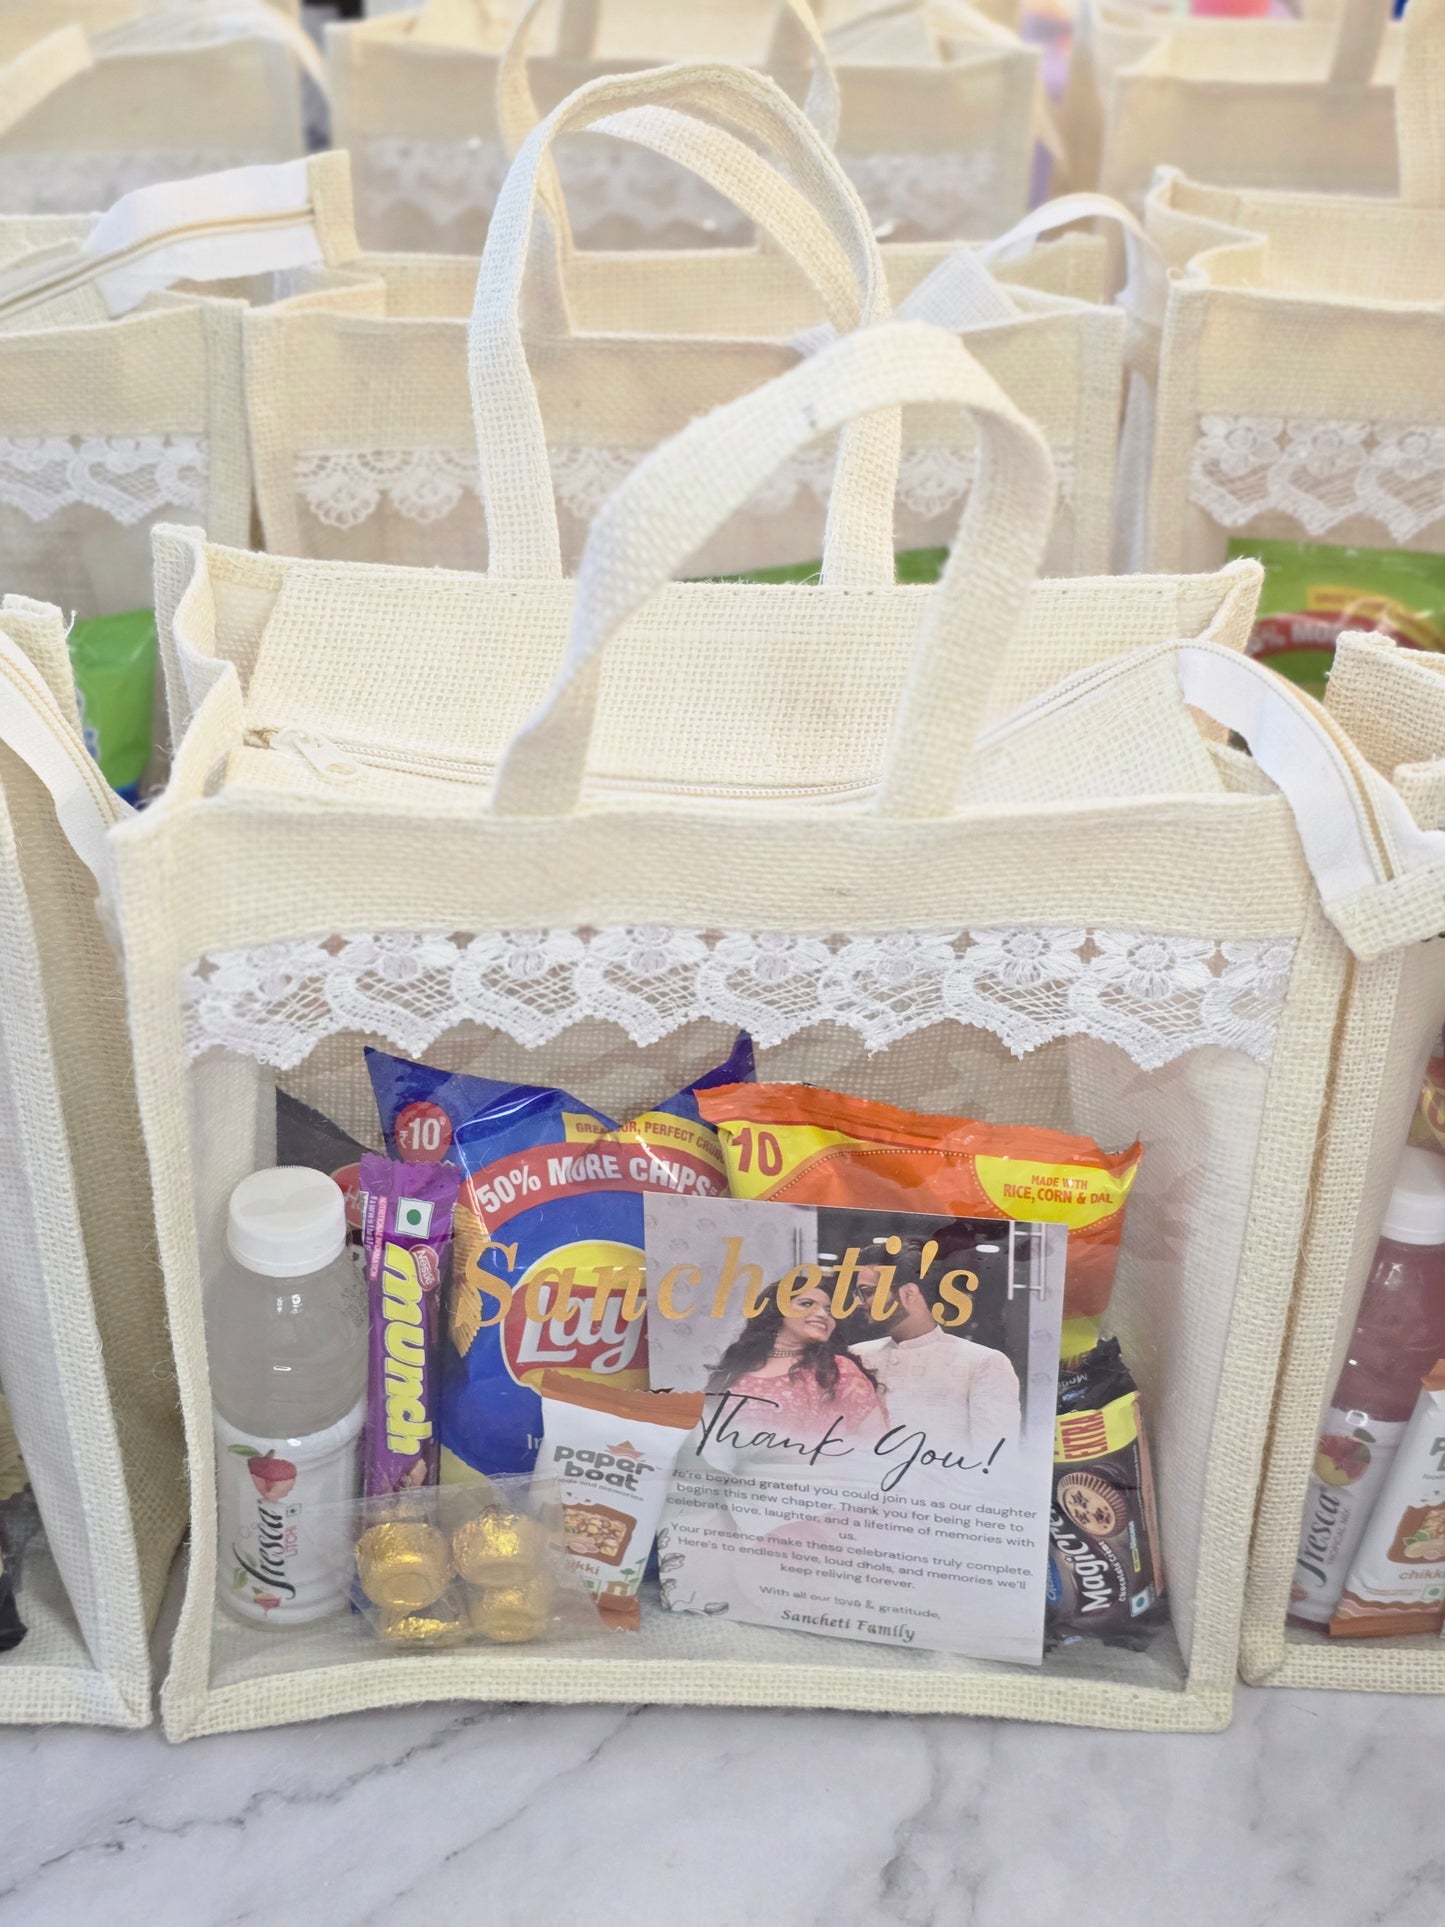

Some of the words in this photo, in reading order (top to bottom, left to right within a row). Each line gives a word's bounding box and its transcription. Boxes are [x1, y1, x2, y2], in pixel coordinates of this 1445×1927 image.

[645, 1122, 695, 1143] PERFECT
[731, 1127, 784, 1177] 10
[476, 1165, 542, 1213] 50%
[547, 1153, 623, 1187] MORE
[1003, 1184, 1036, 1204] RICE,
[1037, 1188, 1073, 1204] CORN
[1076, 1192, 1087, 1205] &
[1090, 1193, 1113, 1204] DAL
[1031, 1175, 1060, 1188] MADE
[1062, 1178, 1088, 1190] WITH
[455, 1235, 980, 1328] Sancheti's
[696, 1390, 855, 1466] Thank
[874, 1424, 1006, 1493] You!
[1060, 1409, 1109, 1460] EXTRA
[553, 1445, 655, 1476] paper
[564, 1461, 639, 1492] boat
[676, 1482, 720, 1496] begins
[724, 1488, 748, 1500] this
[751, 1493, 777, 1503] new
[781, 1496, 836, 1511] chapter.
[839, 1501, 880, 1515] Thank
[882, 1508, 908, 1520] you
[911, 1511, 931, 1521] for
[934, 1513, 971, 1528] being
[975, 1517, 1006, 1530] here
[1009, 1523, 1025, 1533] to
[705, 1472, 756, 1487] beyond
[759, 1477, 810, 1493] grateful
[813, 1486, 838, 1497] you
[842, 1489, 880, 1502] could
[882, 1493, 907, 1505] join
[911, 1499, 926, 1507] us
[930, 1501, 946, 1509] as
[949, 1503, 972, 1511] our
[975, 1503, 1038, 1520] daughter
[665, 1495, 729, 1511] celebrate
[732, 1503, 762, 1516] love,
[764, 1507, 821, 1524] laughter,
[824, 1515, 849, 1527] and
[853, 1520, 861, 1528] a
[864, 1520, 914, 1534] lifetime
[918, 1525, 932, 1536] of
[935, 1530, 1002, 1545] memories
[1006, 1538, 1036, 1549] with
[838, 1531, 857, 1541] us.
[670, 1521, 700, 1534] Your
[703, 1524, 764, 1543] presence
[768, 1533, 803, 1548] make
[806, 1539, 843, 1553] these
[846, 1546, 929, 1564] celebrations
[932, 1556, 963, 1570] truly
[966, 1561, 1034, 1578] complete.
[677, 1536, 718, 1550] Here's
[722, 1543, 736, 1553] to
[738, 1545, 789, 1559] endless
[791, 1551, 822, 1565] love,
[824, 1555, 854, 1568] loud
[856, 1561, 895, 1575] dhols,
[898, 1566, 924, 1577] and
[927, 1569, 994, 1587] memories
[997, 1578, 1027, 1591] we'll
[780, 1563, 813, 1577] keep
[815, 1569, 863, 1584] reliving
[865, 1573, 916, 1590] forever.
[759, 1585, 790, 1598] With
[792, 1591, 807, 1600] all
[810, 1594, 831, 1602] our
[834, 1596, 862, 1608] love
[864, 1599, 875, 1610] &
[878, 1603, 942, 1620] gratitude,
[781, 1609, 851, 1629] Sancheti
[856, 1620, 916, 1643] Family
